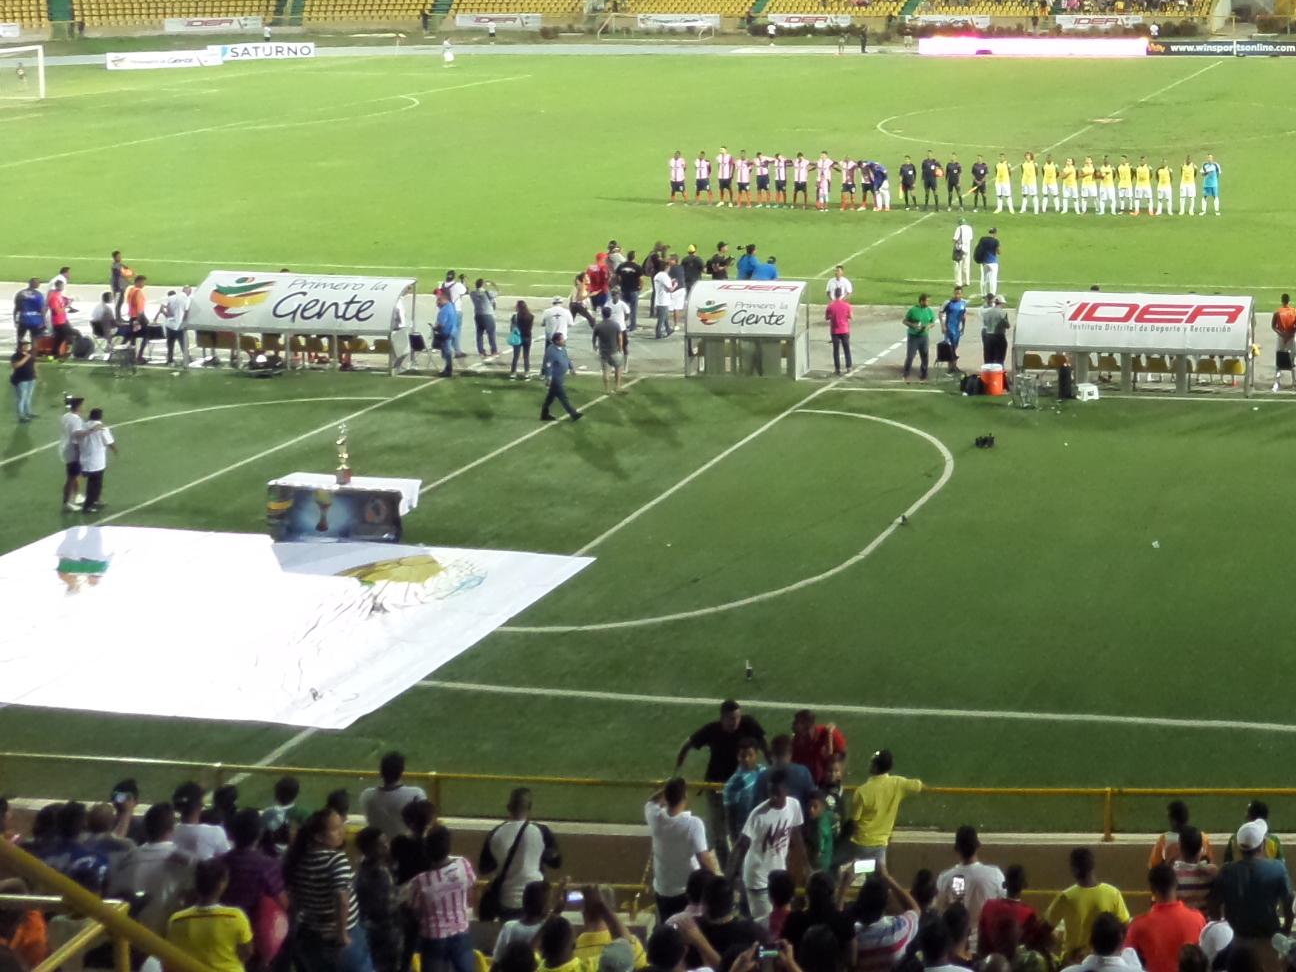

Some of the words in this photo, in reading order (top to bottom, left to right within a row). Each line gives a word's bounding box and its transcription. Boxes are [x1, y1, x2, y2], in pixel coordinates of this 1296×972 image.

[230, 45, 312, 58] SATURNO
[1170, 43, 1296, 54] www.winsportsonline.com
[287, 278, 362, 291] Primero
[370, 280, 388, 292] la
[272, 291, 376, 324] Gente
[734, 300, 777, 310] Primero
[780, 300, 789, 310] la
[730, 309, 785, 327] Gente
[1070, 323, 1104, 331] Instituto
[1105, 324, 1137, 332] Distrital
[1150, 325, 1181, 334] Deporte
[1190, 325, 1232, 333] Recreación
